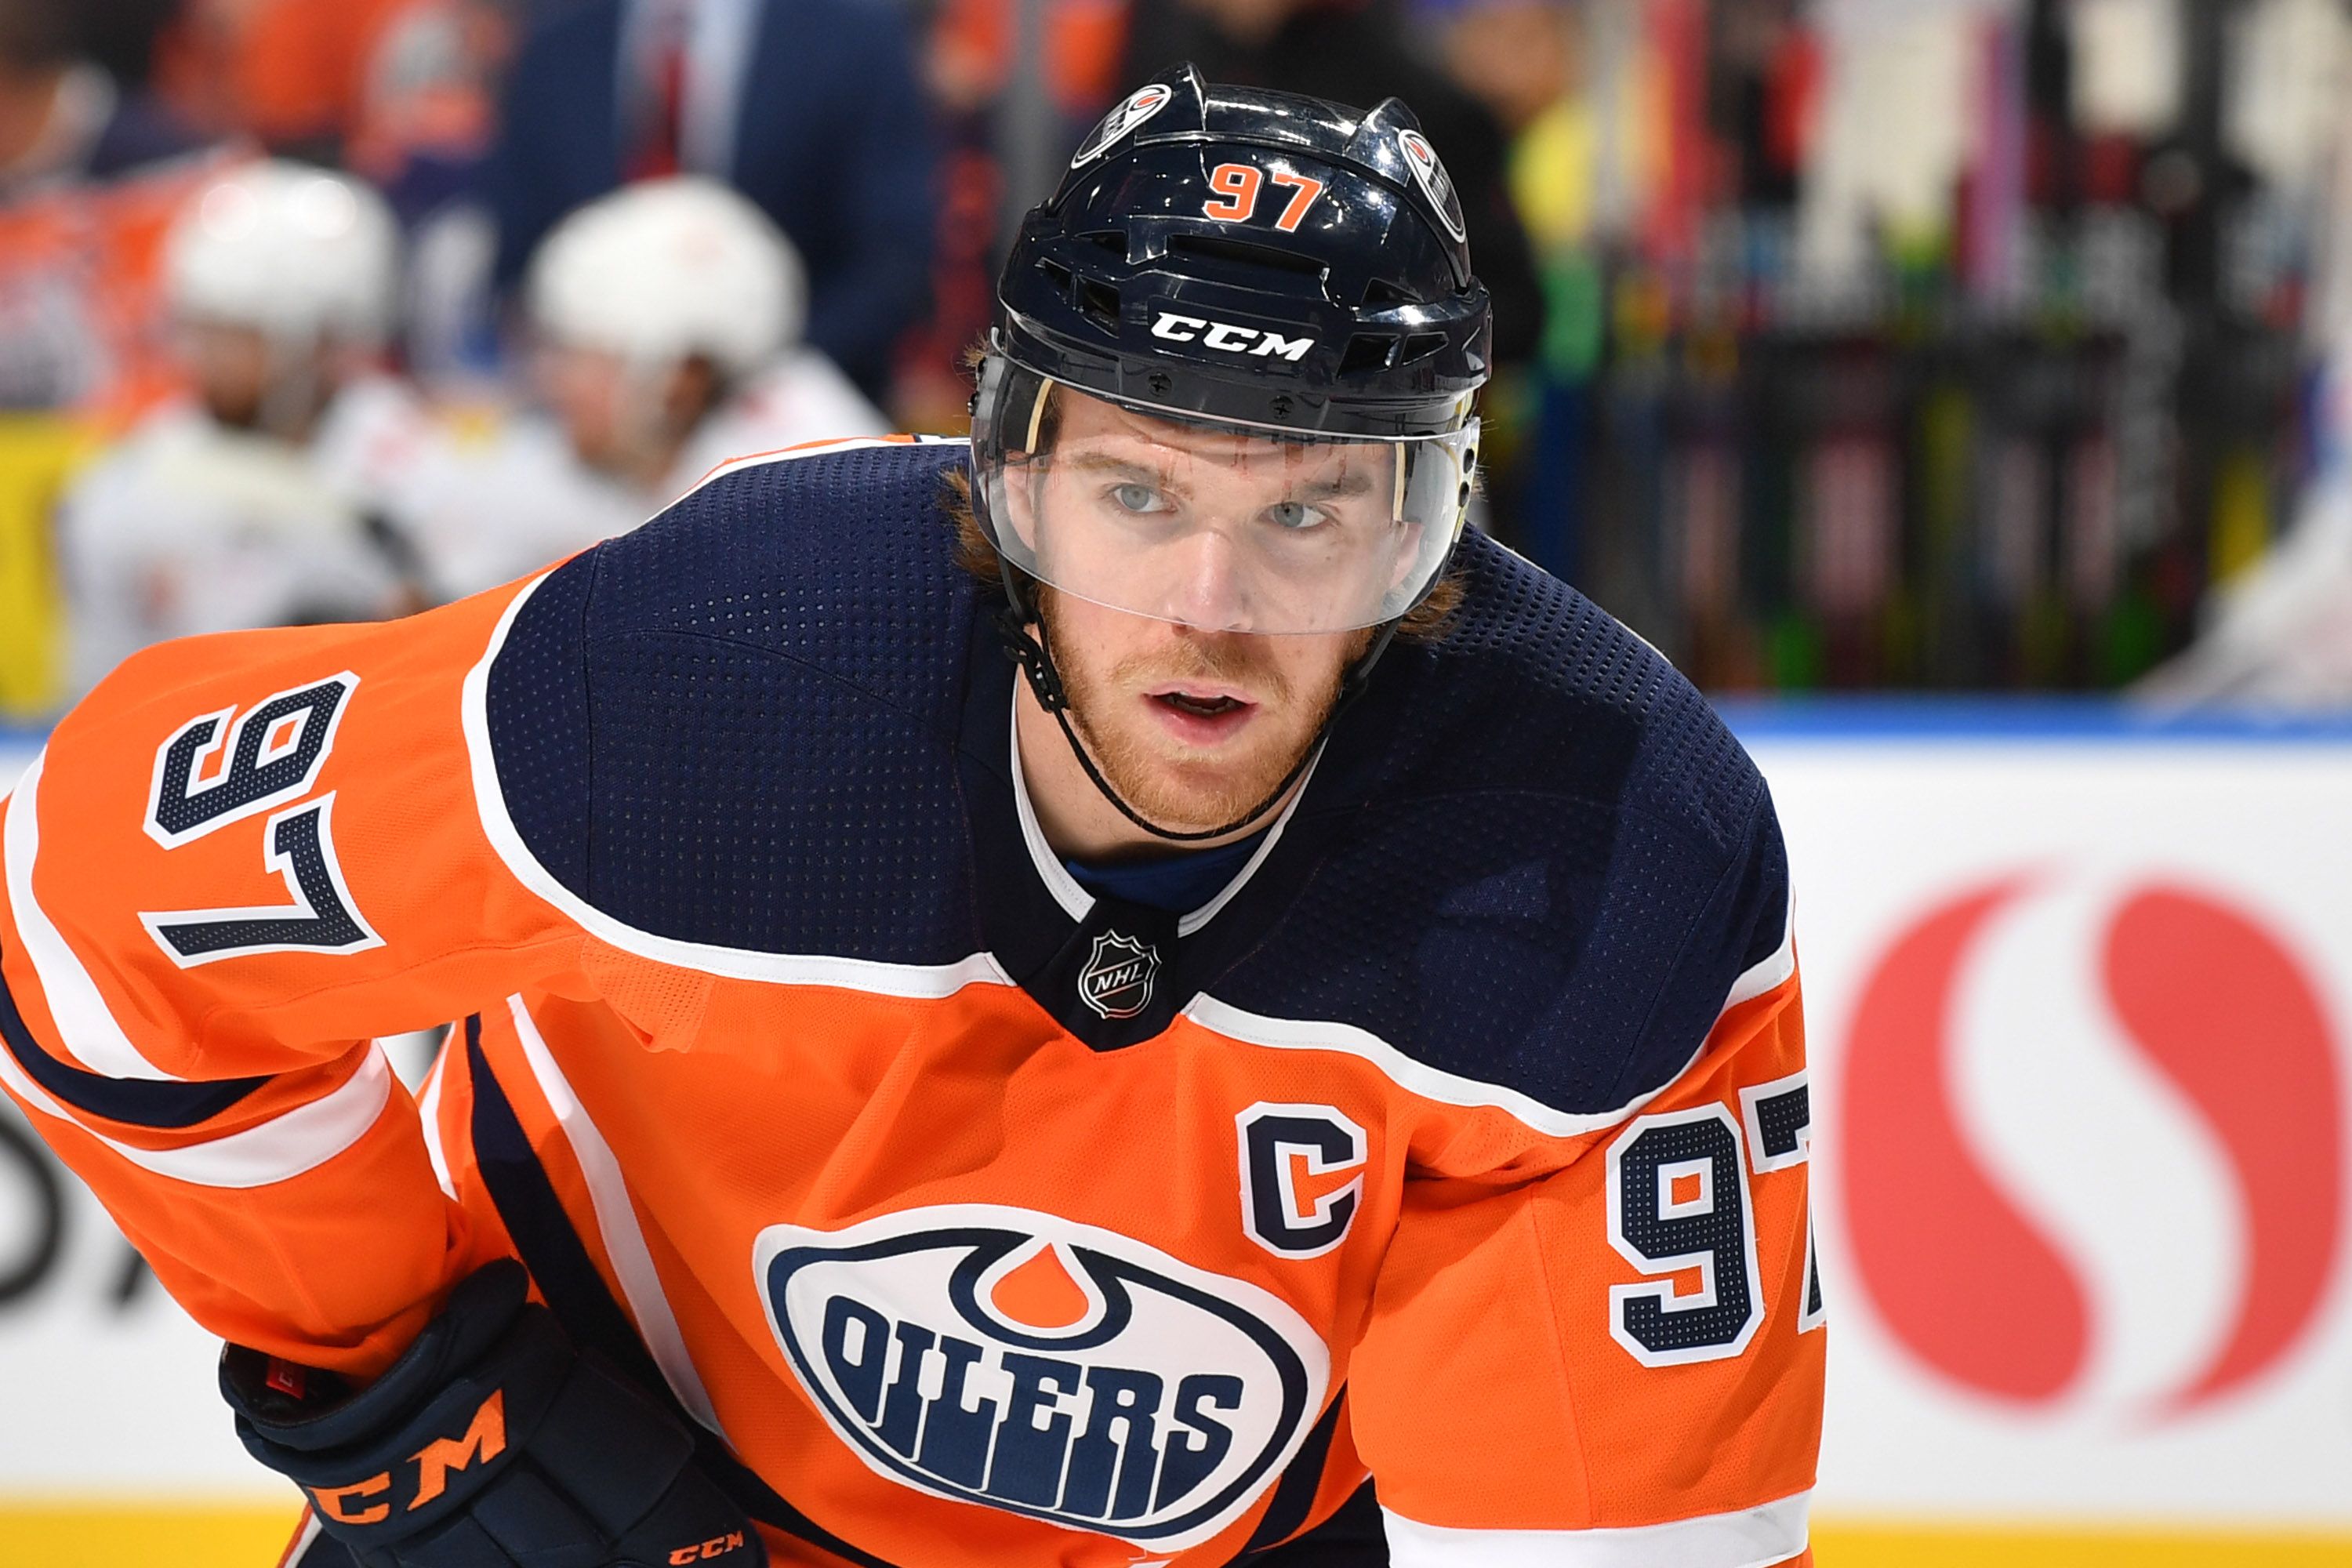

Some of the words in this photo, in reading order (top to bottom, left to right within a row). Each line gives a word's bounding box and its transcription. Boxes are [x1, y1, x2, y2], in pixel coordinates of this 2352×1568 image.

[1203, 163, 1323, 233] 97
[1151, 312, 1315, 361] CCM
[137, 670, 387, 969] 97
[1094, 964, 1144, 994] NHL
[1236, 1102, 1367, 1259] C
[822, 1295, 1243, 1520] OILERS
[669, 1530, 744, 1566] CCM
